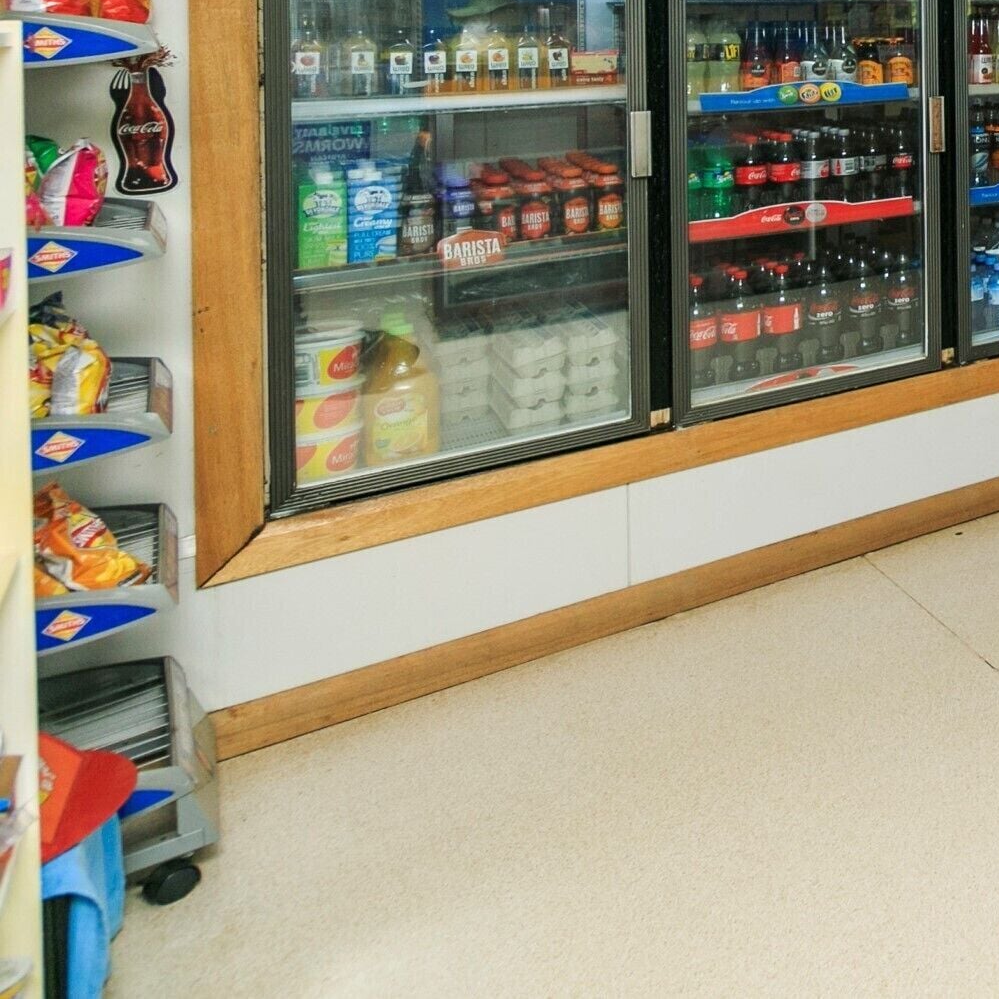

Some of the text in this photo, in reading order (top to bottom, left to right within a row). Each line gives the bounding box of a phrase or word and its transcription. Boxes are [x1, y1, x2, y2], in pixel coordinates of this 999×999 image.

[443, 237, 501, 260] BARISTA
[460, 254, 487, 267] BROS
[816, 310, 834, 318] zero
